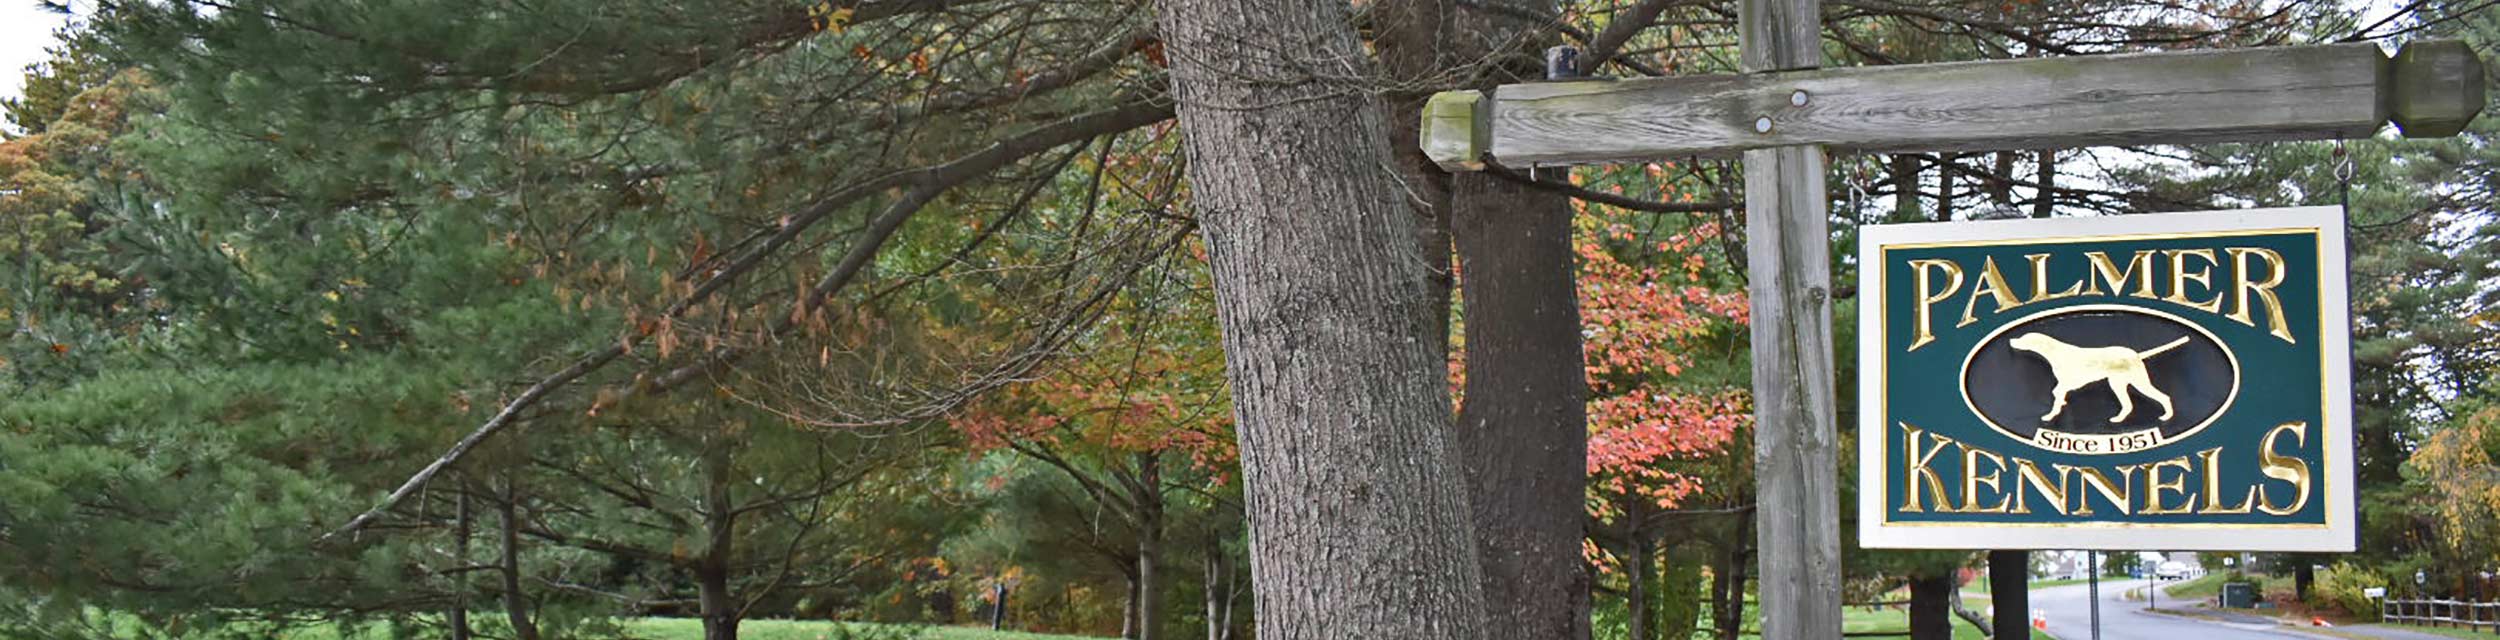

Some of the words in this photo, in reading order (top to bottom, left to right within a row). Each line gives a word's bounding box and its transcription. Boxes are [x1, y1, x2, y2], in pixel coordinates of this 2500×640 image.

[1907, 247, 2295, 352] PALMER
[1898, 420, 2311, 516] KENNELS
[2038, 431, 2098, 452] Since
[2109, 431, 2158, 452] 1951
